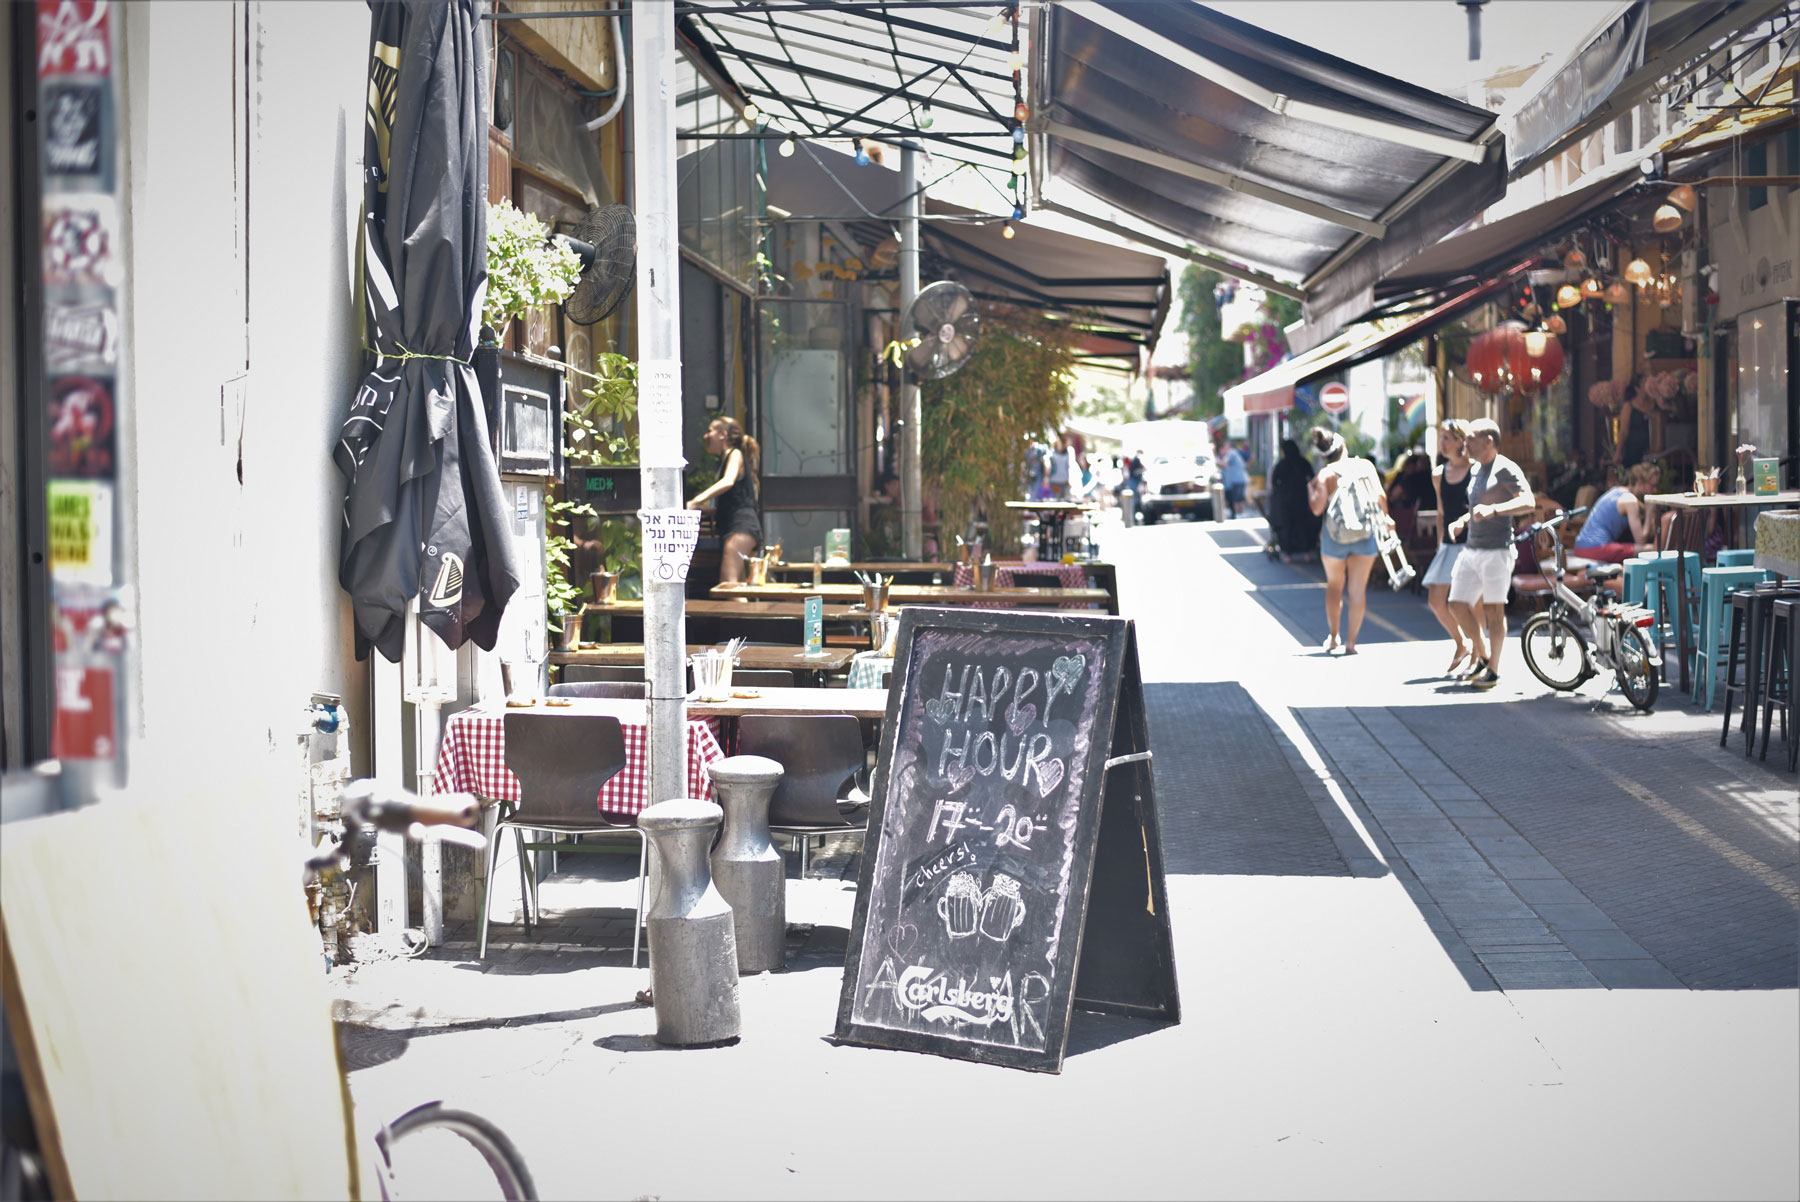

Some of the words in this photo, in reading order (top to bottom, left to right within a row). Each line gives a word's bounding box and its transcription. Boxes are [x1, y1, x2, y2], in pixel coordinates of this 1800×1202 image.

[935, 662, 1067, 728] HAPPY
[938, 728, 1053, 792] HOUR
[898, 965, 1015, 1023] Carlsberg
